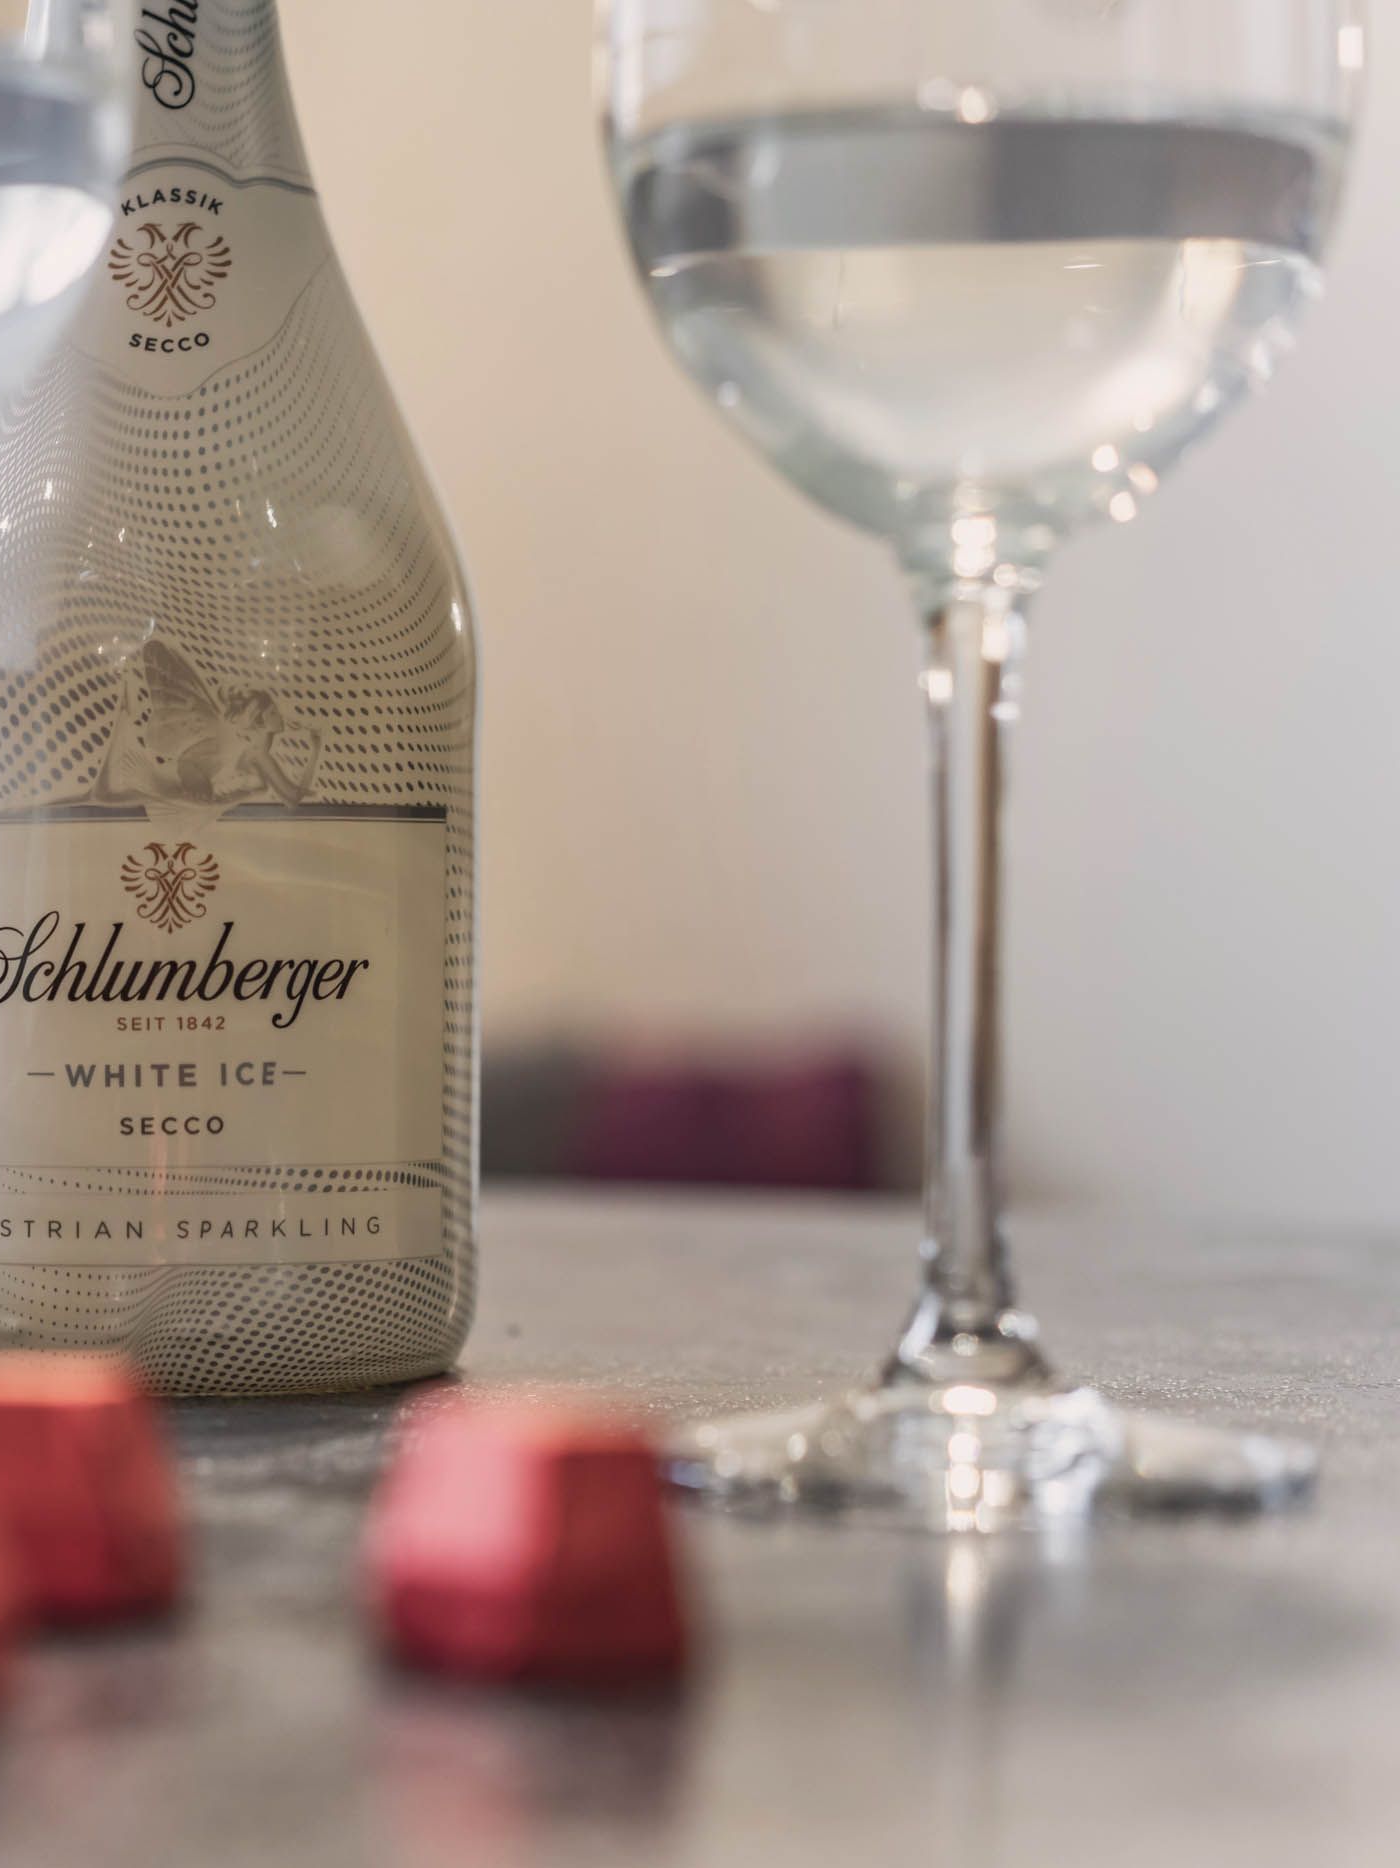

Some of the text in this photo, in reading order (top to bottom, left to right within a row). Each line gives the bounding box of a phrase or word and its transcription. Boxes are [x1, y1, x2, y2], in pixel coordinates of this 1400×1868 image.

[121, 188, 223, 216] KLASSIK
[129, 332, 210, 353] SECCO
[116, 1016, 226, 1031] SEIT 1842
[65, 1062, 277, 1088] WHITE ICE
[120, 1116, 224, 1135] SECCO
[177, 1216, 382, 1239] SPARKLING
